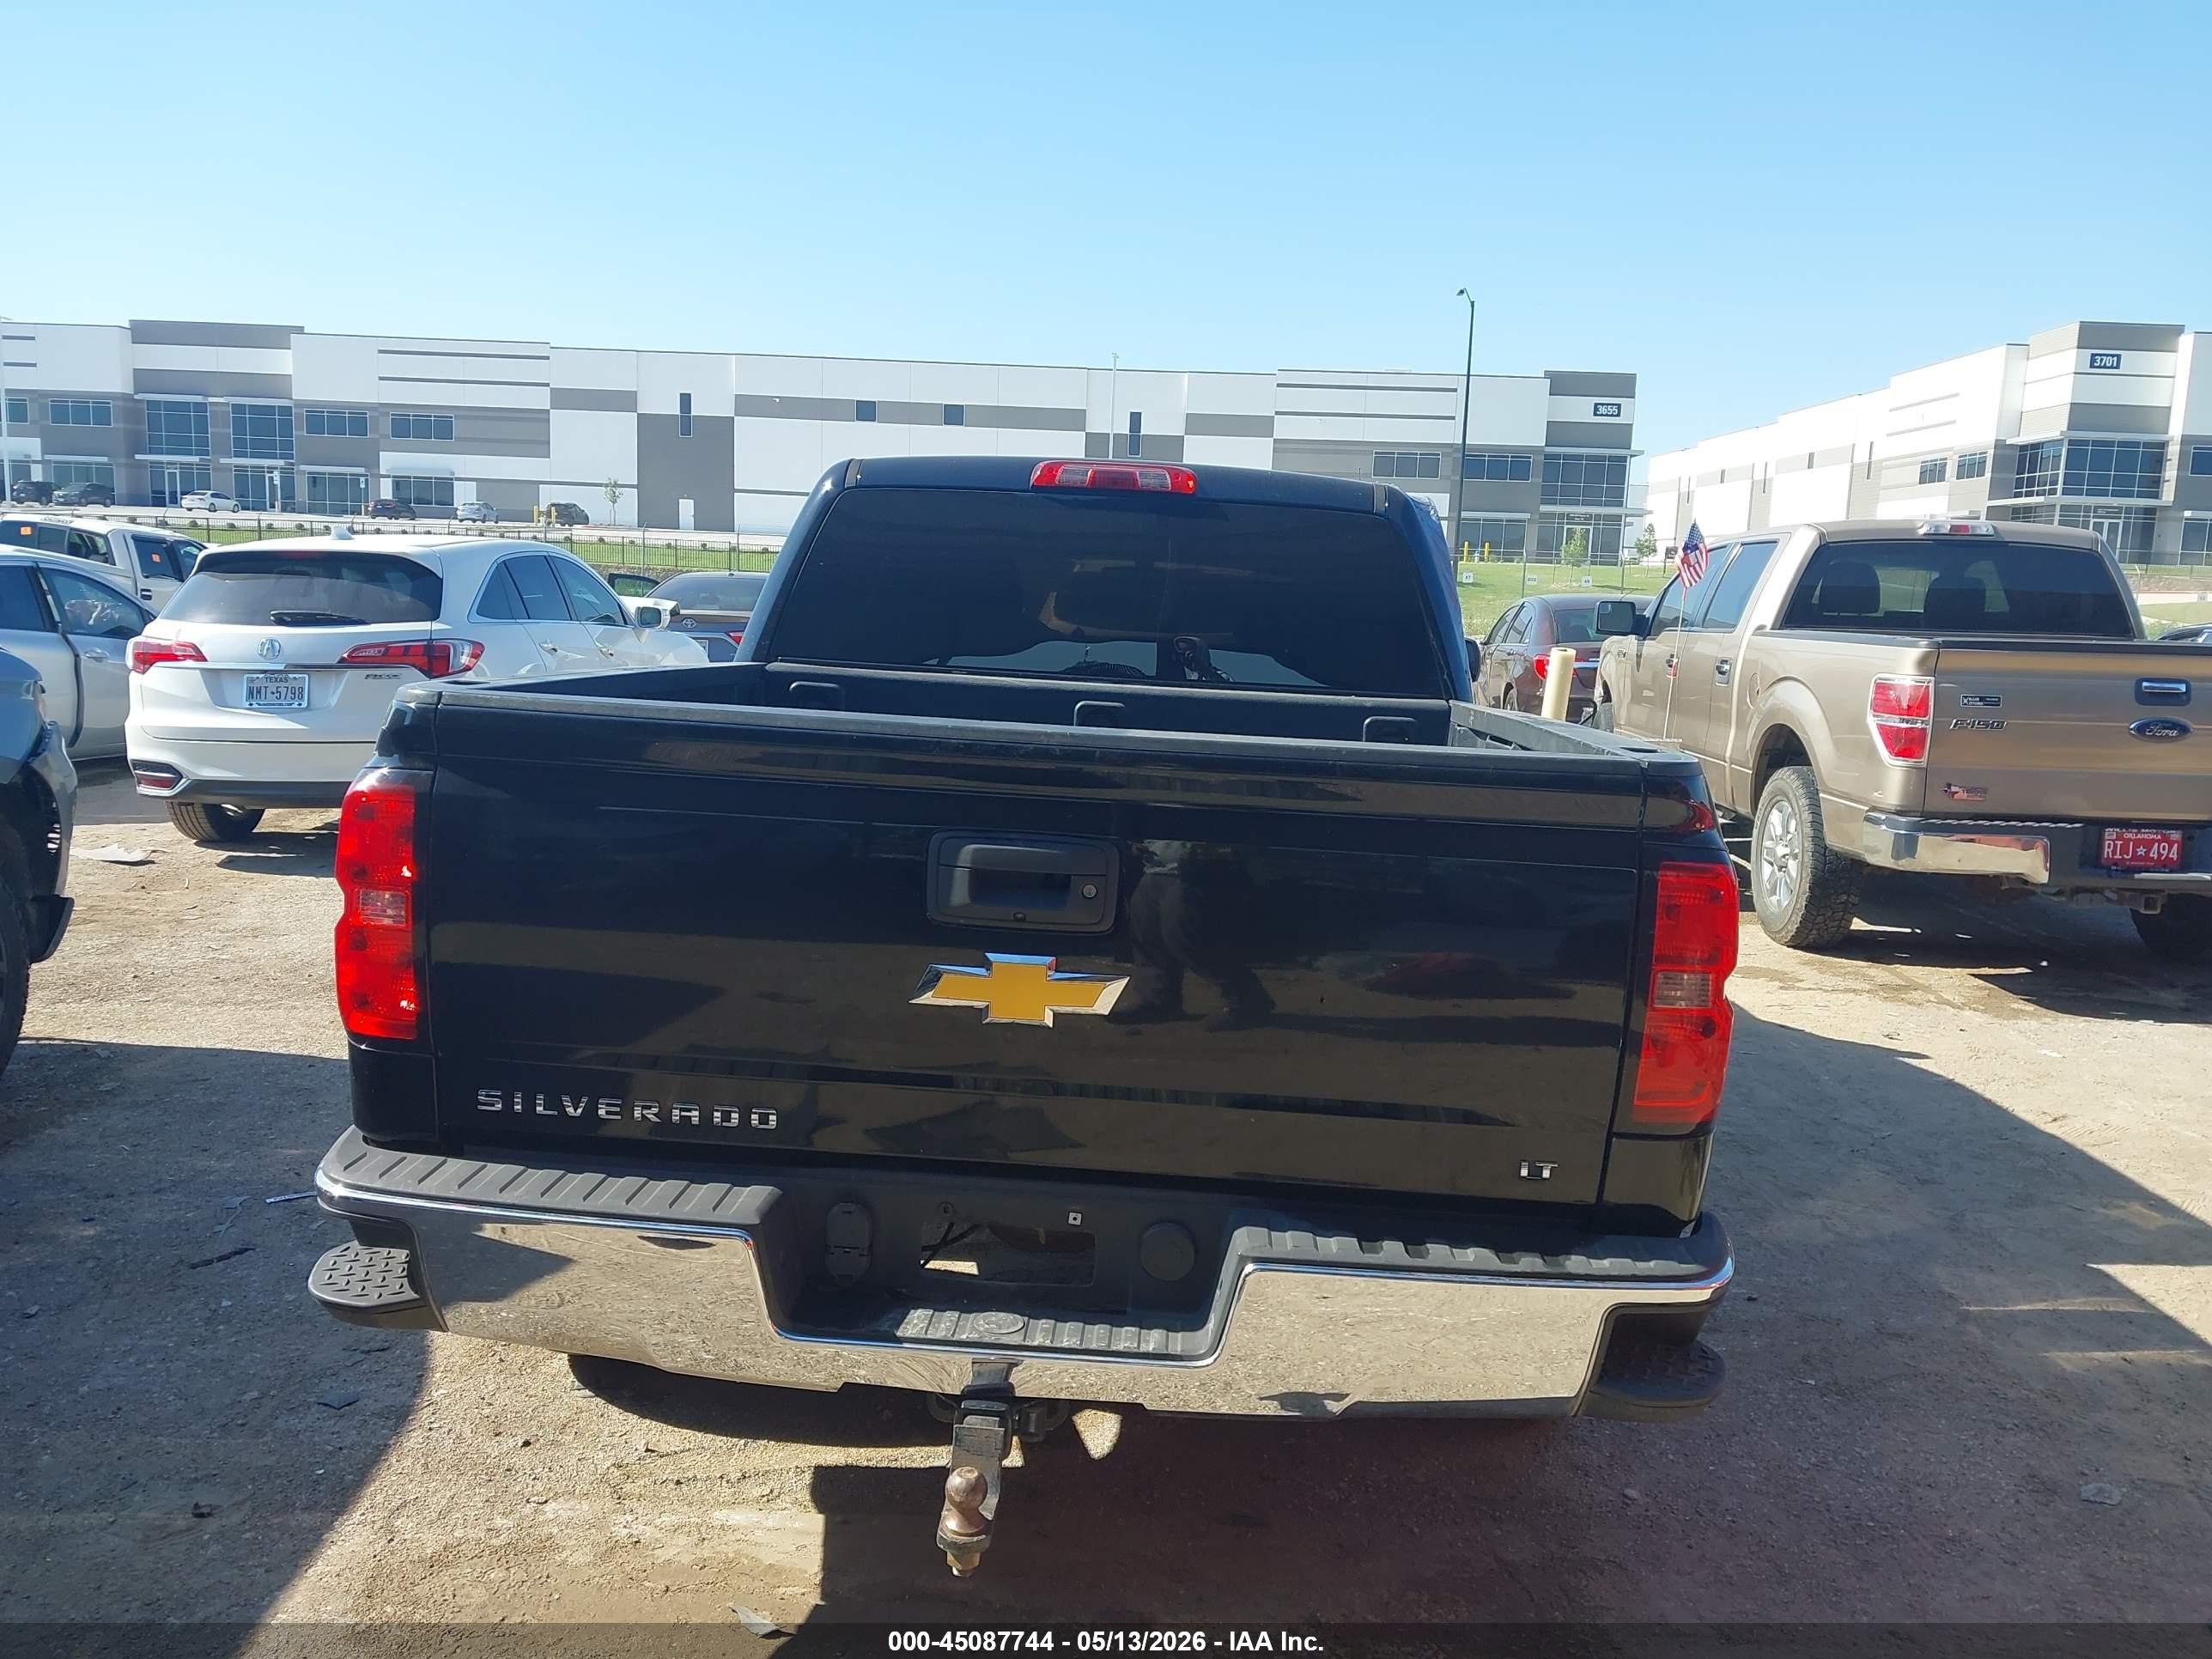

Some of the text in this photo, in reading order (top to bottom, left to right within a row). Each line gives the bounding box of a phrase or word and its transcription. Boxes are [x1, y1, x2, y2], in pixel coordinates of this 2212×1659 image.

[2094, 356, 2118, 367] 3701
[1596, 404, 1619, 415] 3655
[2145, 721, 2179, 737] Ford
[2104, 841, 2179, 861] RIJ 494
[477, 1088, 778, 1130] SILVERADO
[1519, 1159, 1559, 1181] LT
